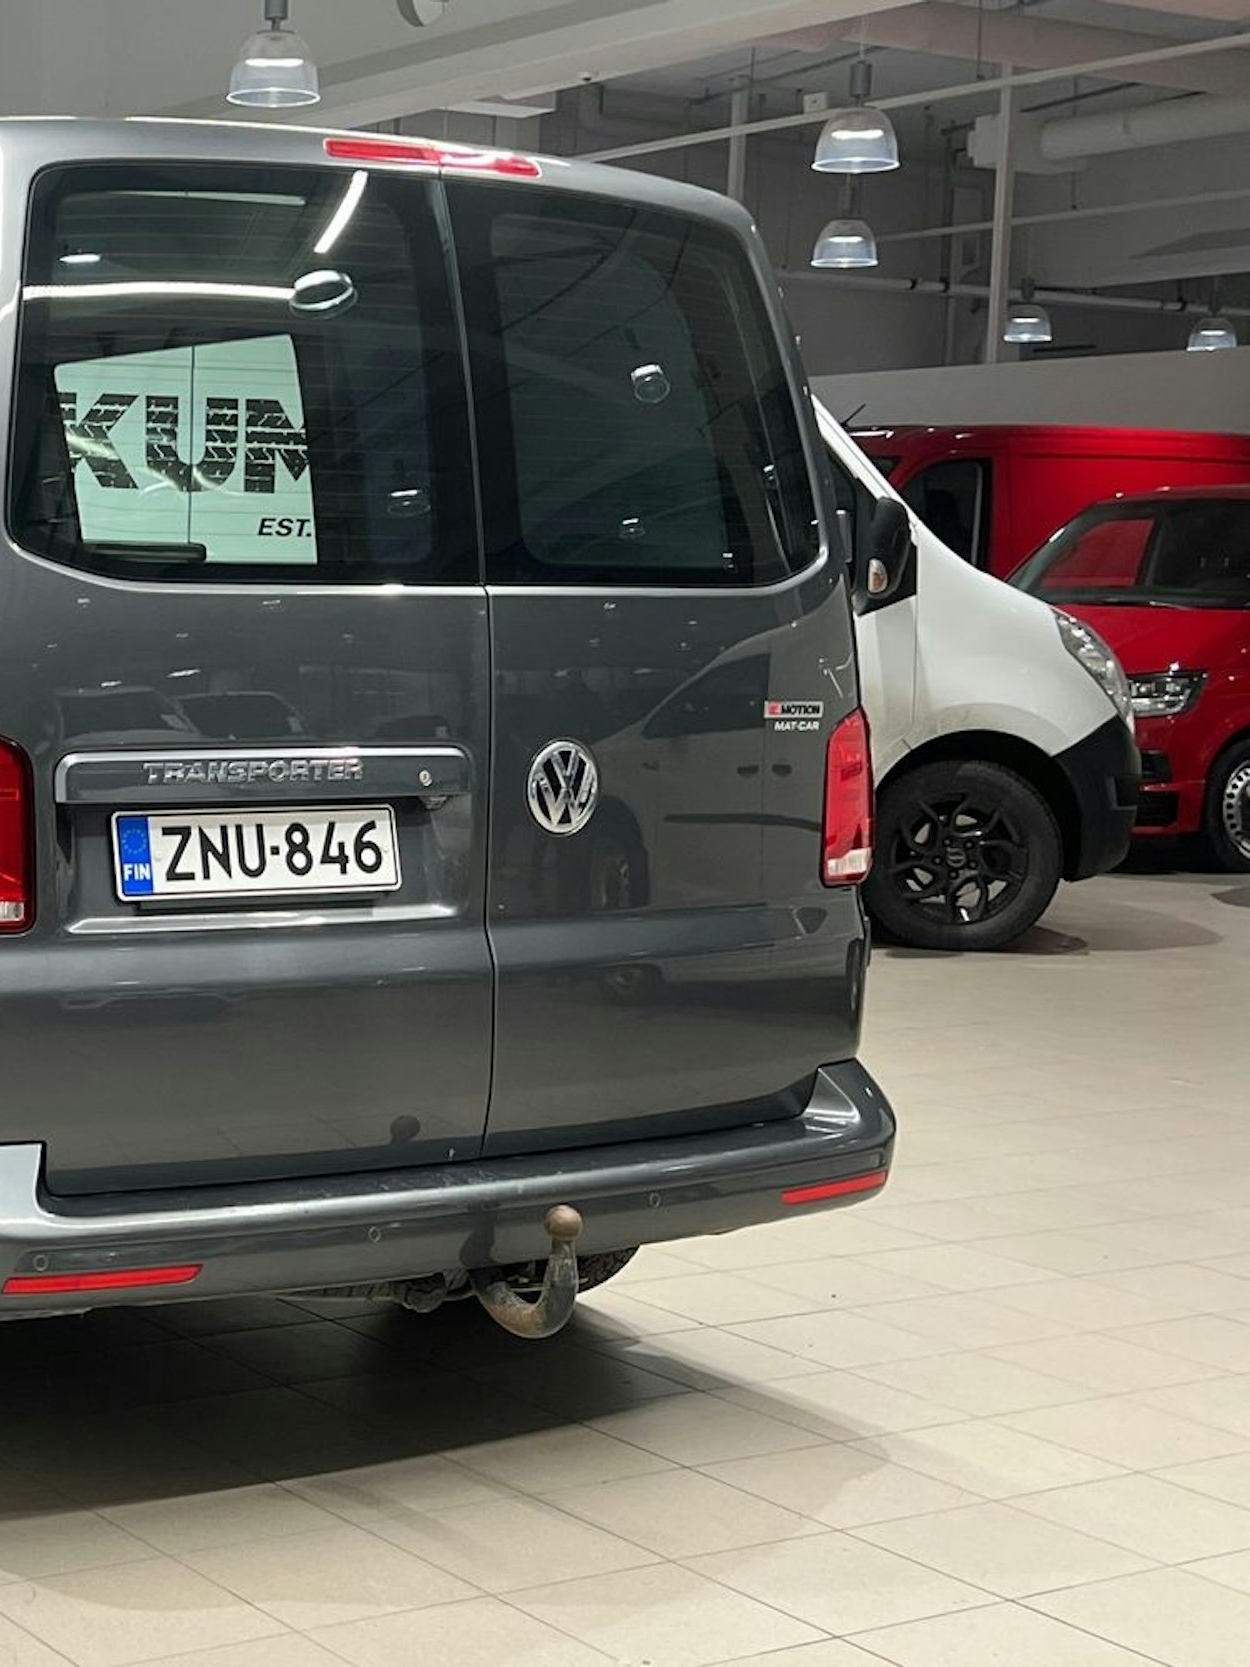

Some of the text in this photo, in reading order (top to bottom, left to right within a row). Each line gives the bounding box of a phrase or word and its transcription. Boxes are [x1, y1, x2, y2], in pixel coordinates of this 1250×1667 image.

[257, 517, 312, 537] EST.
[143, 758, 364, 784] TRANSPORTER
[161, 819, 382, 881] ZNU-846
[124, 863, 150, 880] FIN
